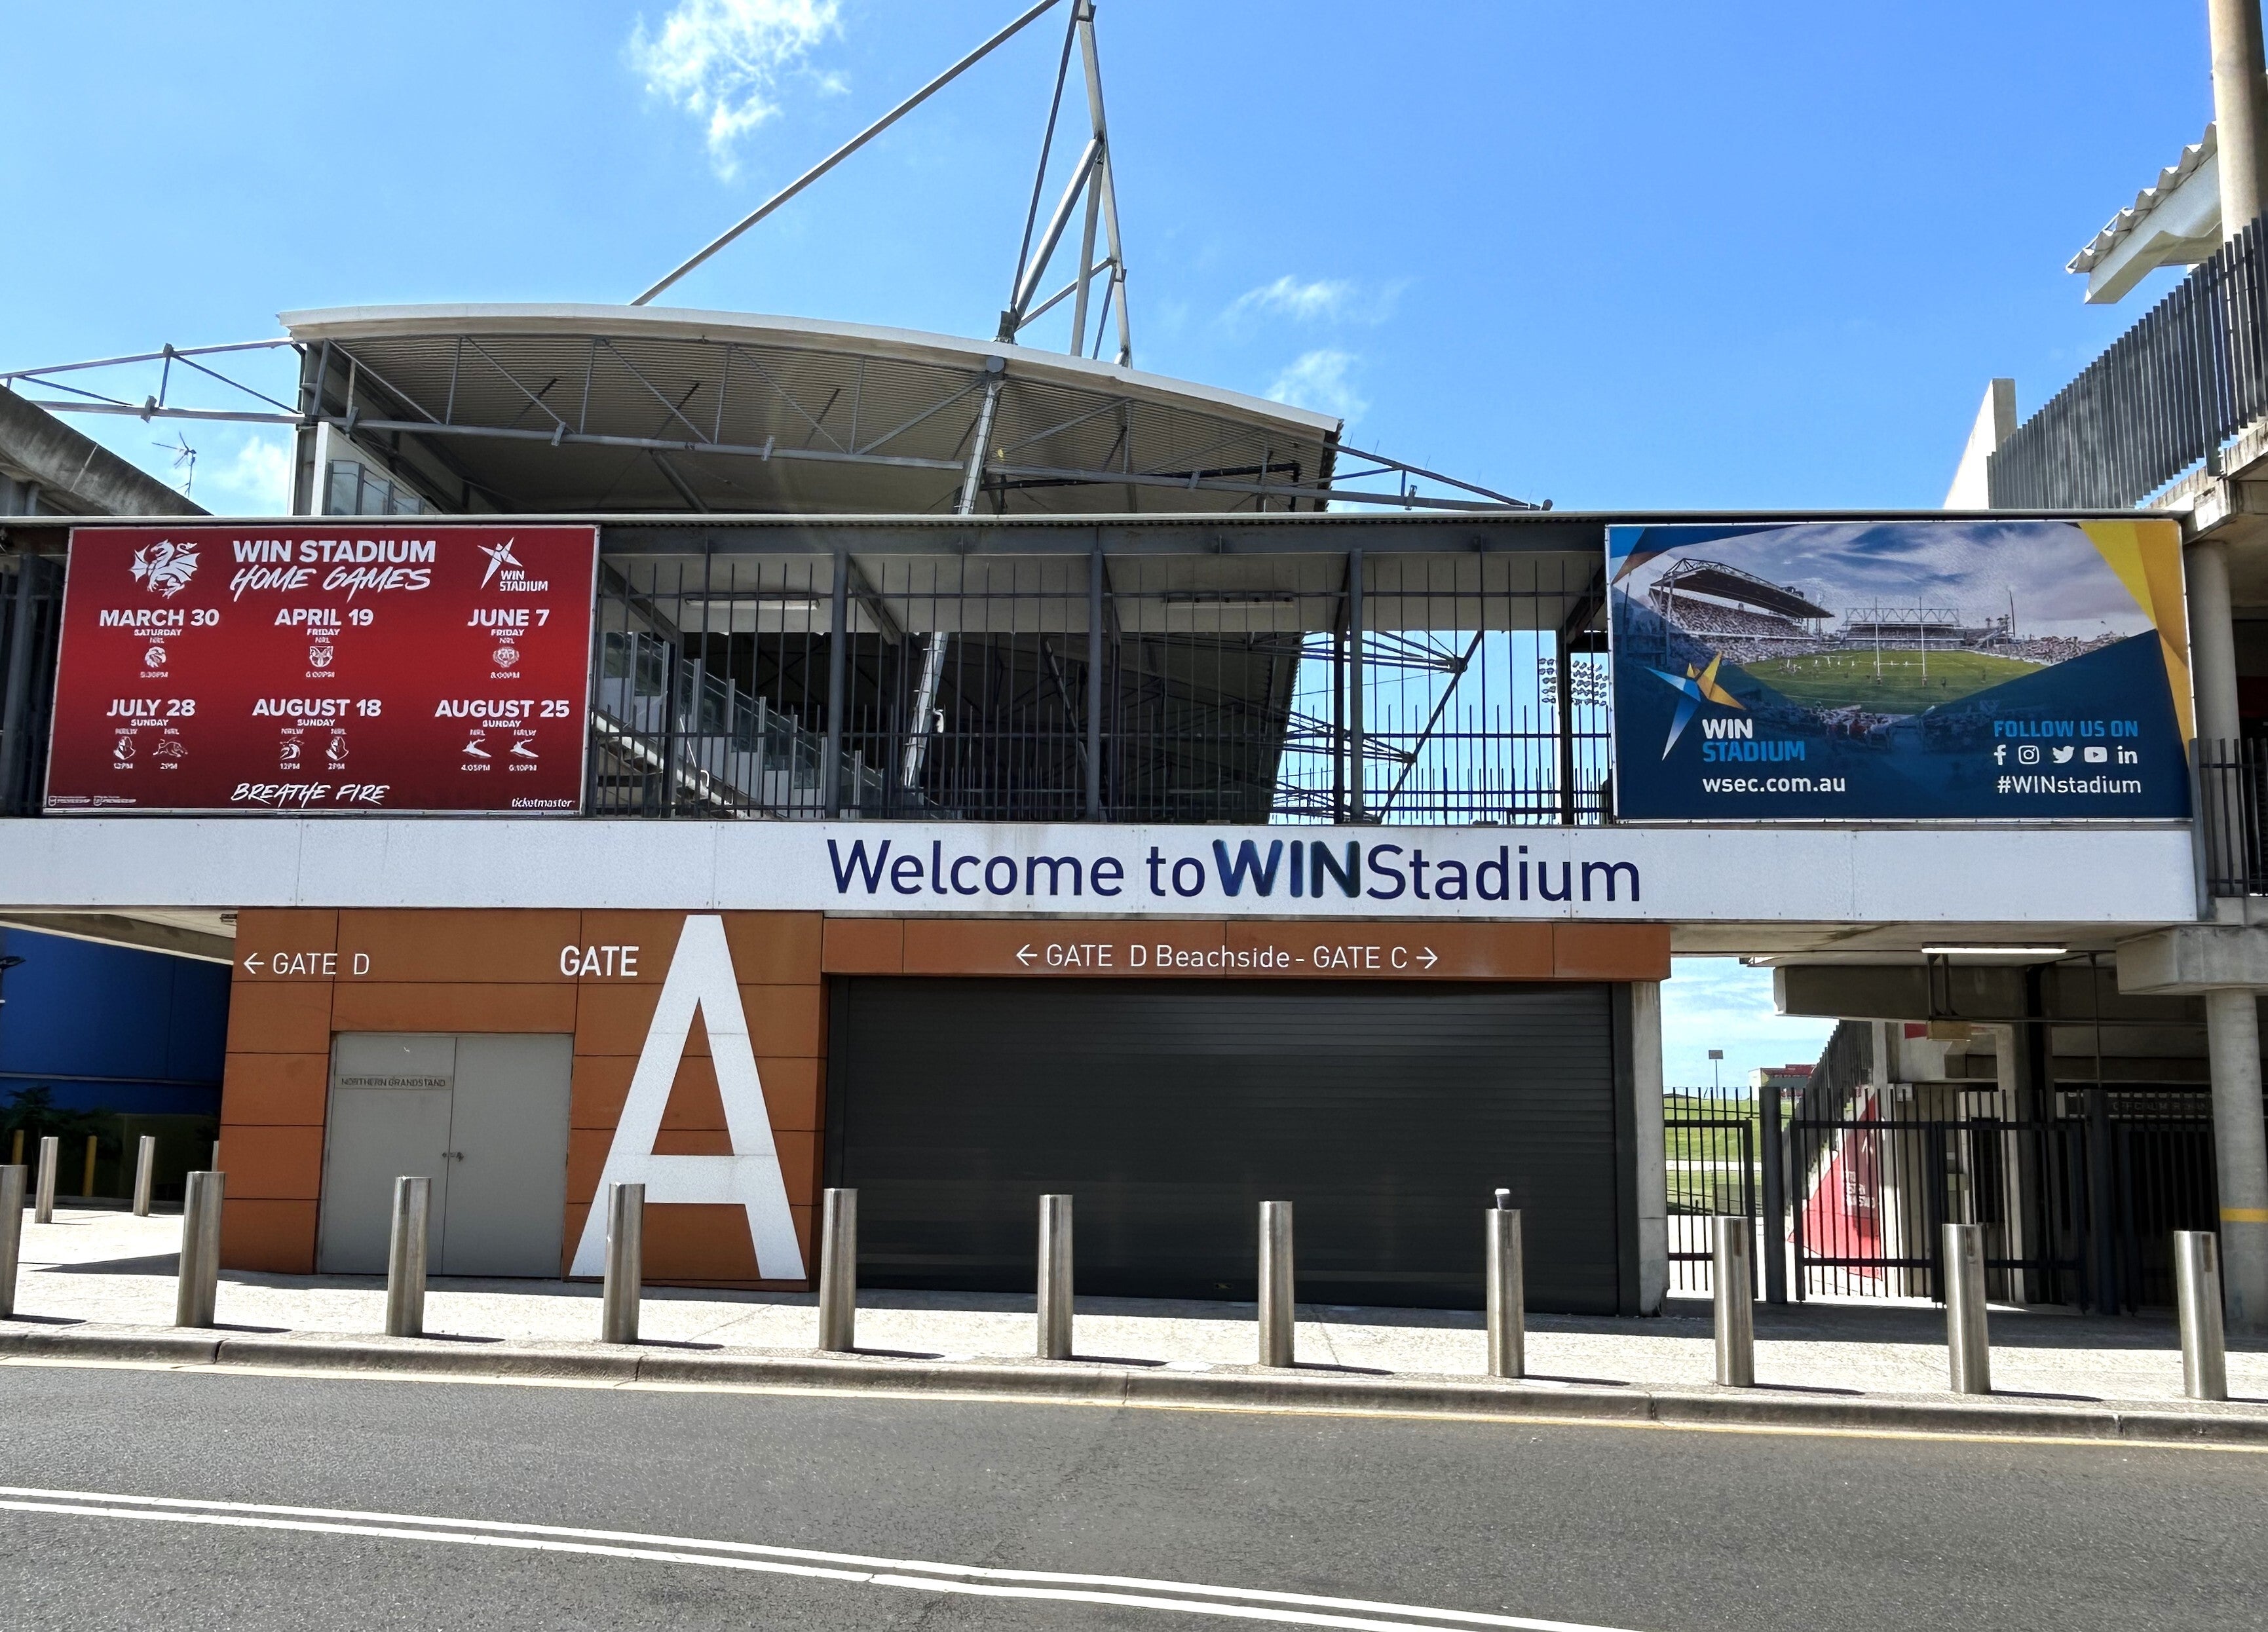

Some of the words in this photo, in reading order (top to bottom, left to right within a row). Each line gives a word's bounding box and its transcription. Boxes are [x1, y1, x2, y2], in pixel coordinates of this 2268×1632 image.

[233, 541, 291, 563] WIN
[299, 541, 436, 563] STADIUM
[230, 565, 316, 602] HOME
[323, 566, 431, 602] GAMES
[501, 571, 525, 580] WIN
[500, 580, 548, 591] STADIUM
[100, 609, 184, 626] MARCH
[191, 609, 219, 626] 30
[274, 609, 341, 625] APRIL
[349, 609, 373, 626] 19
[468, 609, 529, 626] JUNE
[536, 609, 549, 626] 7
[107, 699, 161, 717] JULY
[166, 699, 195, 716] 28
[252, 699, 350, 717] AUGUST
[356, 699, 381, 716] 18
[435, 700, 534, 717] AUGUST
[540, 700, 569, 717] 25
[1702, 719, 1753, 739] WIN
[1995, 721, 2075, 737] FOLLOW
[2081, 721, 2105, 737] US
[2111, 721, 2138, 737] ON
[1703, 741, 1805, 761] STADIUM
[1703, 776, 1845, 793] wsec.com.au
[1997, 775, 2142, 794] #WINstadium
[231, 782, 331, 808] BREATHE
[336, 784, 390, 805] FIRE
[512, 797, 573, 807] ticketmaster
[827, 839, 1124, 896] Welcome
[1147, 846, 1205, 897] to
[273, 953, 337, 975] GATE
[354, 953, 369, 975] D
[561, 945, 639, 977] GATE
[1046, 944, 1113, 967] GATE
[1131, 945, 1146, 967] D
[1314, 945, 1381, 969] GATE
[1391, 946, 1407, 969] C
[341, 1078, 387, 1086] NORTHERN
[569, 915, 806, 1280] A
